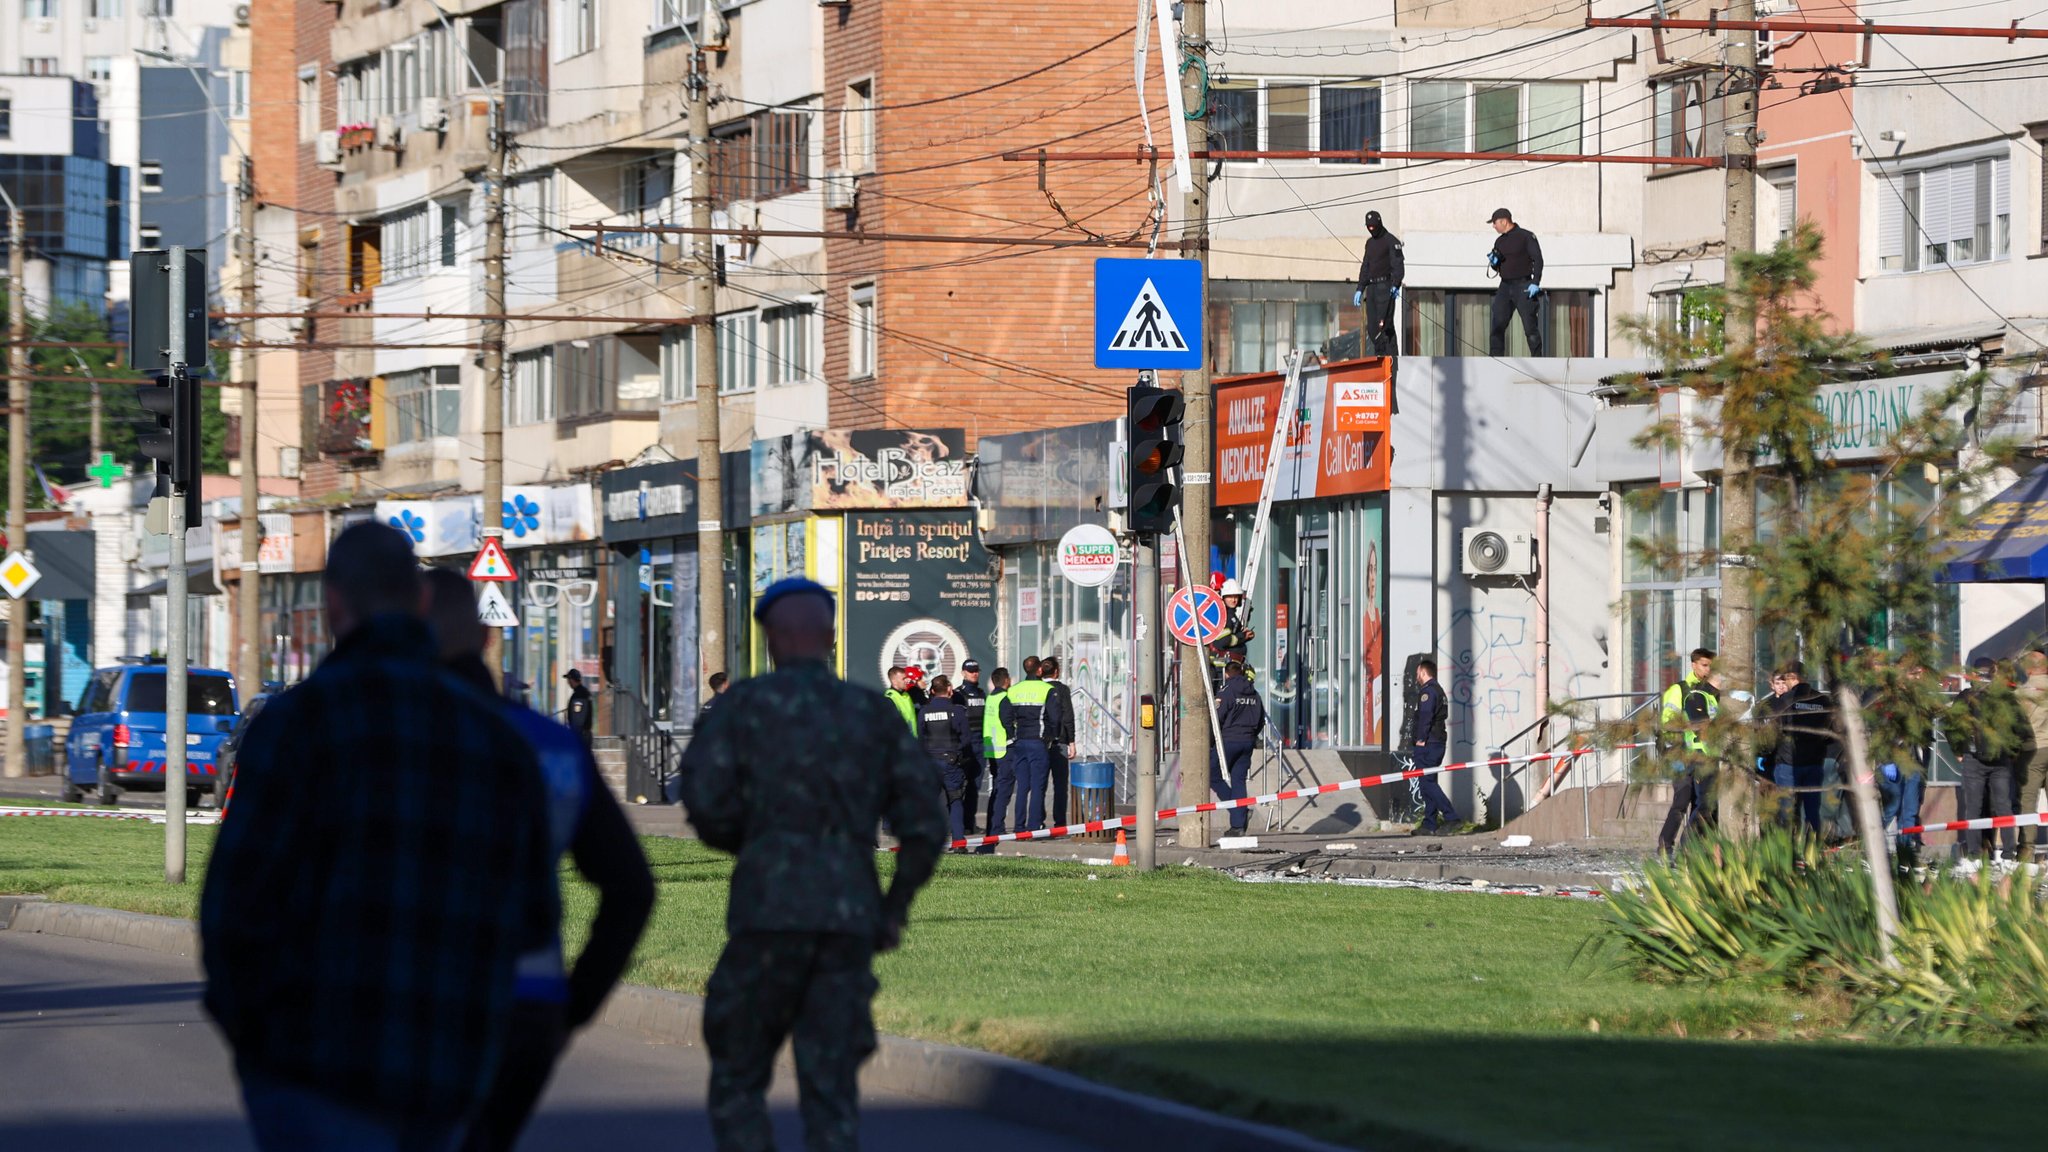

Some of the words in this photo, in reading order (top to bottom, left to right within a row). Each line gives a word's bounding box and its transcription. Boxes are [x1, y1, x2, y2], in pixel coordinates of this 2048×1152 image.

[1353, 389, 1379, 401] SANTE
[1228, 396, 1265, 436] ANALIZE
[1868, 384, 1915, 449] BANK
[814, 450, 886, 486] Hotel
[885, 449, 965, 487] Bicaz
[1221, 443, 1265, 485] MEDICALE
[1325, 435, 1343, 477] Call
[1343, 432, 1375, 473] Center
[919, 519, 974, 541] spiritul
[859, 541, 912, 564] Pirates
[916, 541, 970, 562] Resort!
[1065, 554, 1113, 565] MERCATO
[1078, 545, 1112, 555] SUPER
